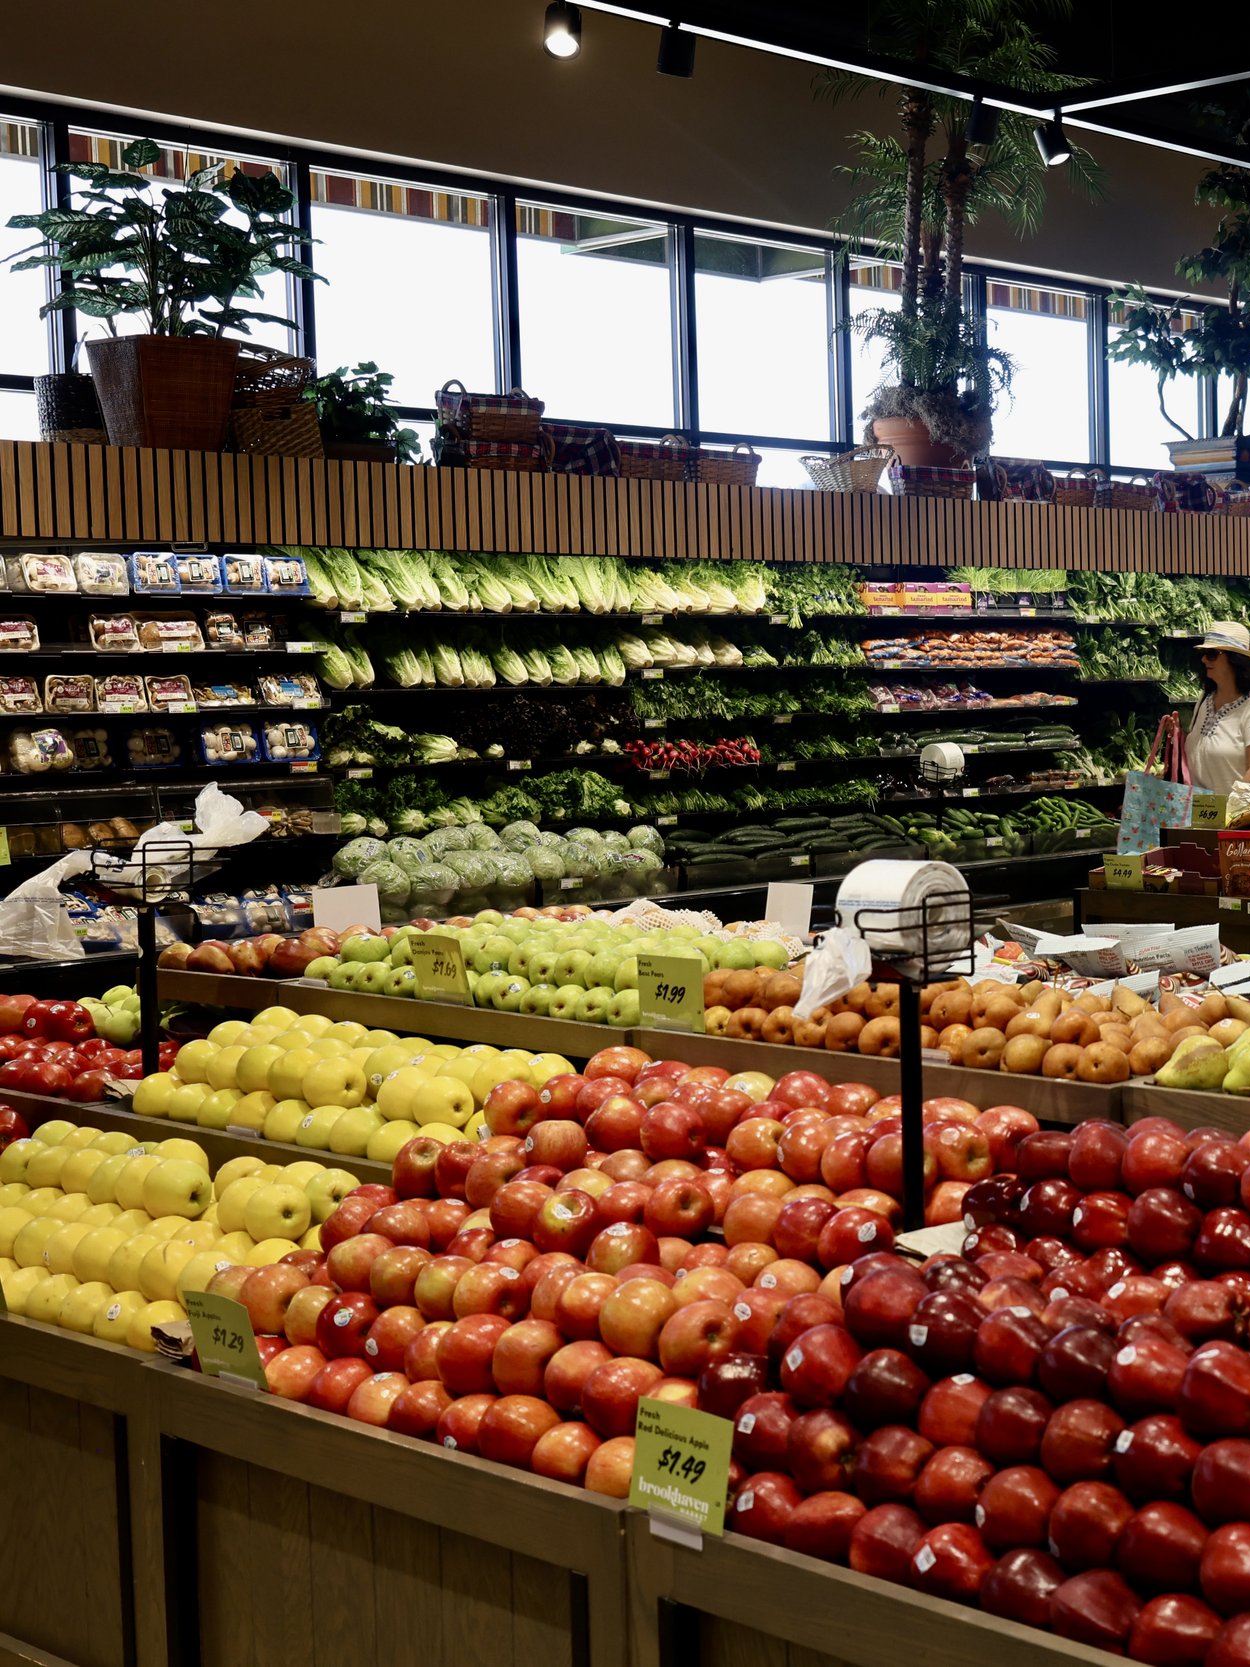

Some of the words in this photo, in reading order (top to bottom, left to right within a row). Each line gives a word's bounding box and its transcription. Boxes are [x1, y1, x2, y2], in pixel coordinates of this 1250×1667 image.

[1199, 810, 1218, 820] $6.99
[1113, 868, 1132, 878] $4.49
[432, 958, 456, 979] $1.69
[655, 982, 686, 1004] $1.99
[213, 1325, 244, 1353] $1.29
[640, 1407, 660, 1420] Fresh
[638, 1420, 653, 1434] Red
[654, 1426, 687, 1443] Delicious
[658, 1445, 706, 1484] $1.49
[638, 1475, 709, 1513] brookhaven
